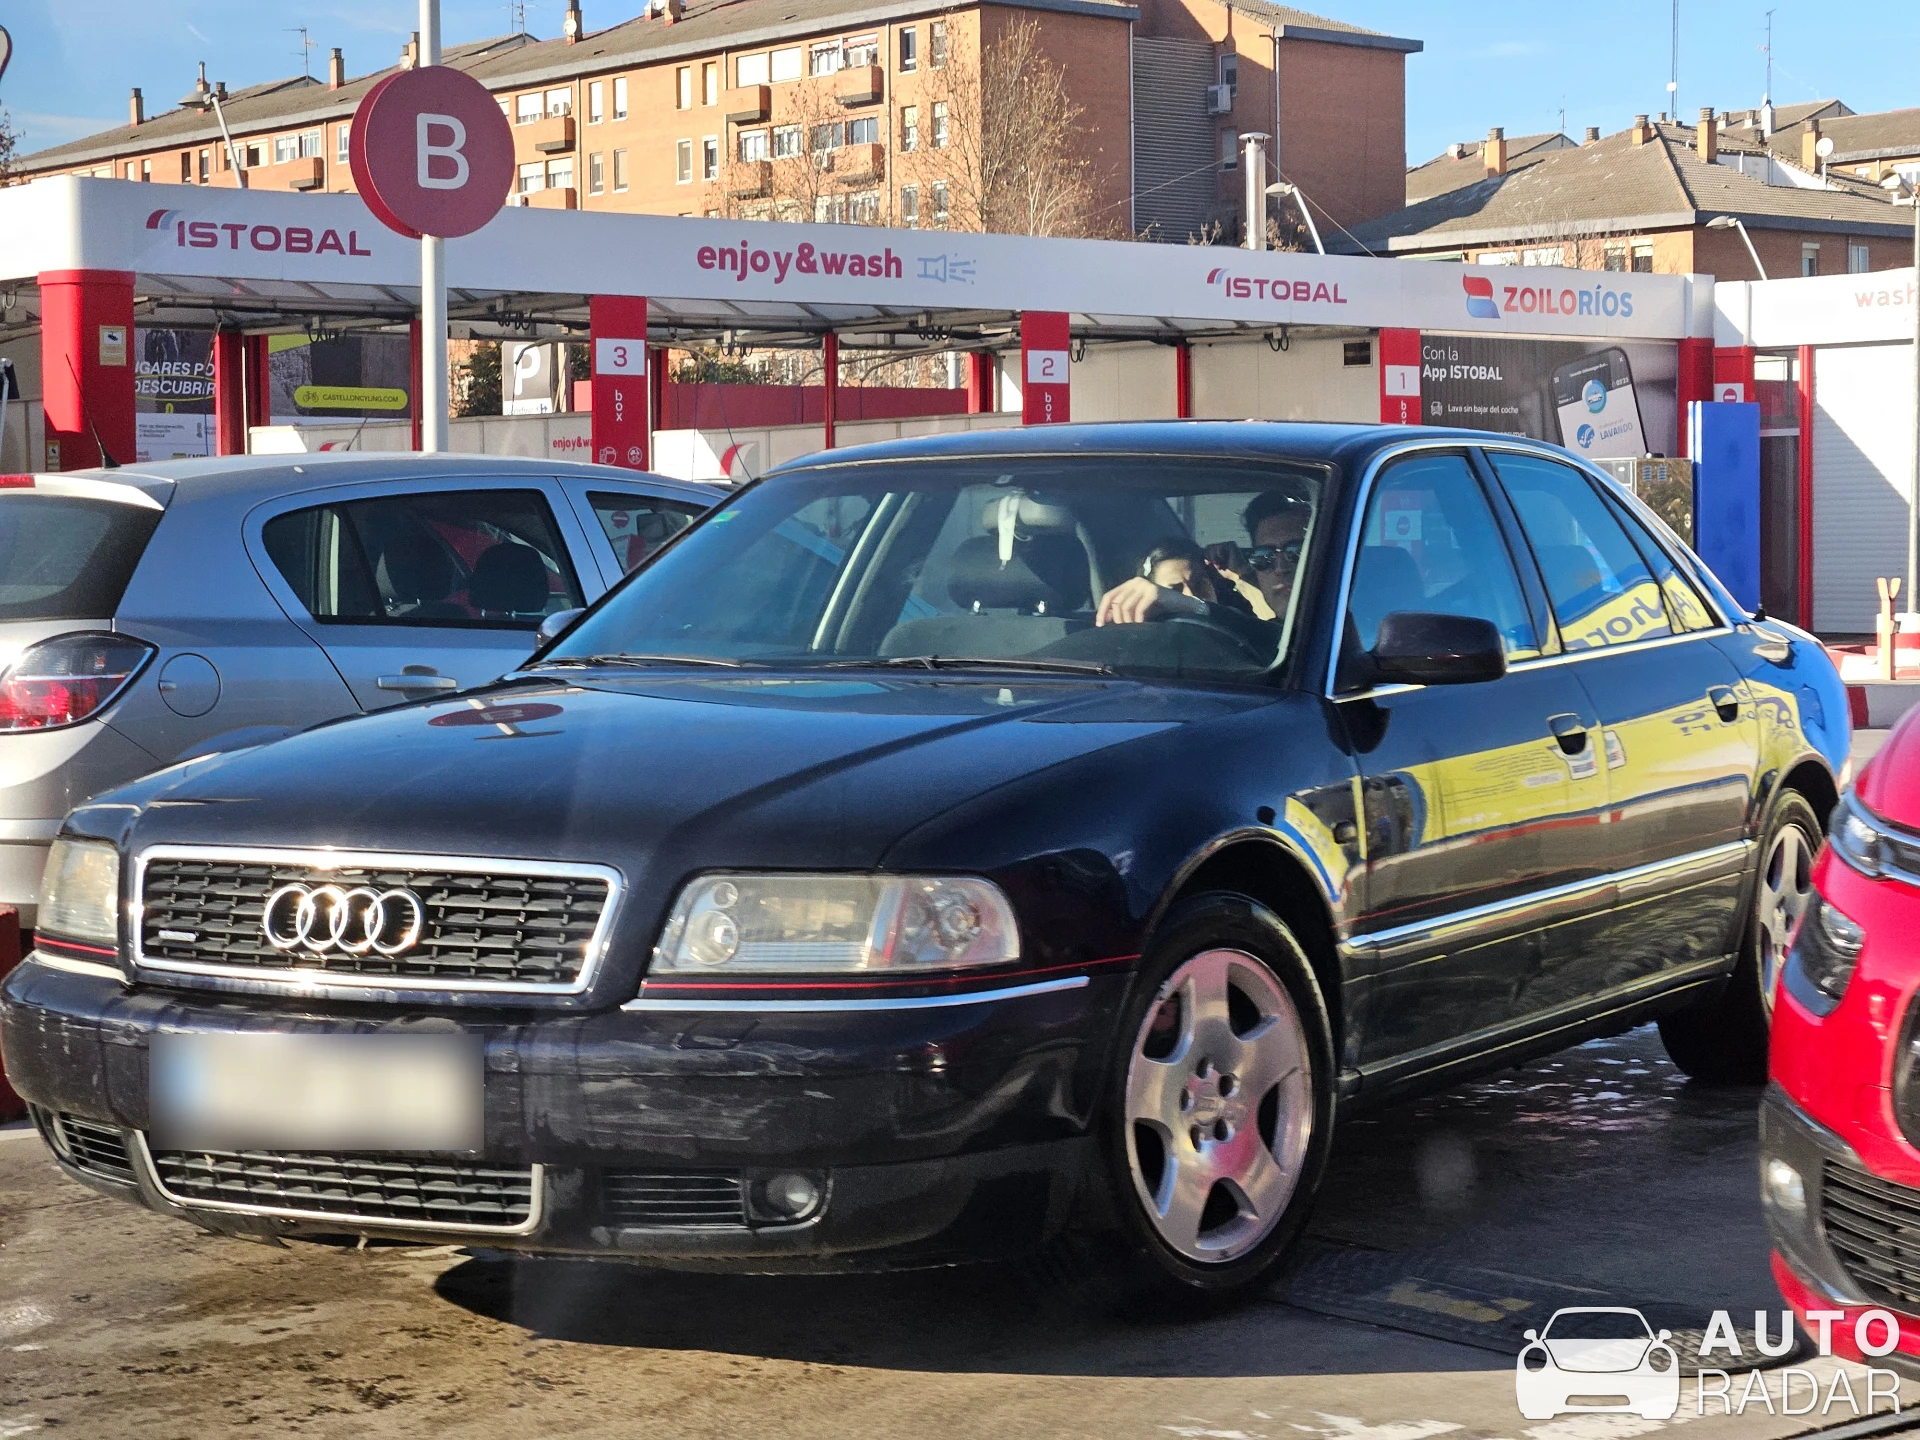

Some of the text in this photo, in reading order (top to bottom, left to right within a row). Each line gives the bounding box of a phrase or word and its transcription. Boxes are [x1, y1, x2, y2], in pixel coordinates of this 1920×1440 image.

[417, 113, 470, 190] B
[177, 214, 372, 257] ISTOBAL
[696, 239, 903, 284] enjoy&wash
[1225, 276, 1348, 304] ISTOBAL
[613, 346, 628, 367] 3
[1422, 345, 1459, 361] Con la
[513, 344, 541, 396] P
[1042, 357, 1054, 377] 2
[1422, 363, 1503, 382] App ISTOBAL
[1400, 372, 1406, 389] 1
[615, 389, 623, 422] box
[1044, 391, 1053, 422] box
[1463, 405, 1473, 413] sin
[1473, 404, 1489, 415] bajar
[1489, 405, 1500, 414] del
[1500, 405, 1519, 414] coche
[1600, 422, 1633, 440] LAVANDO
